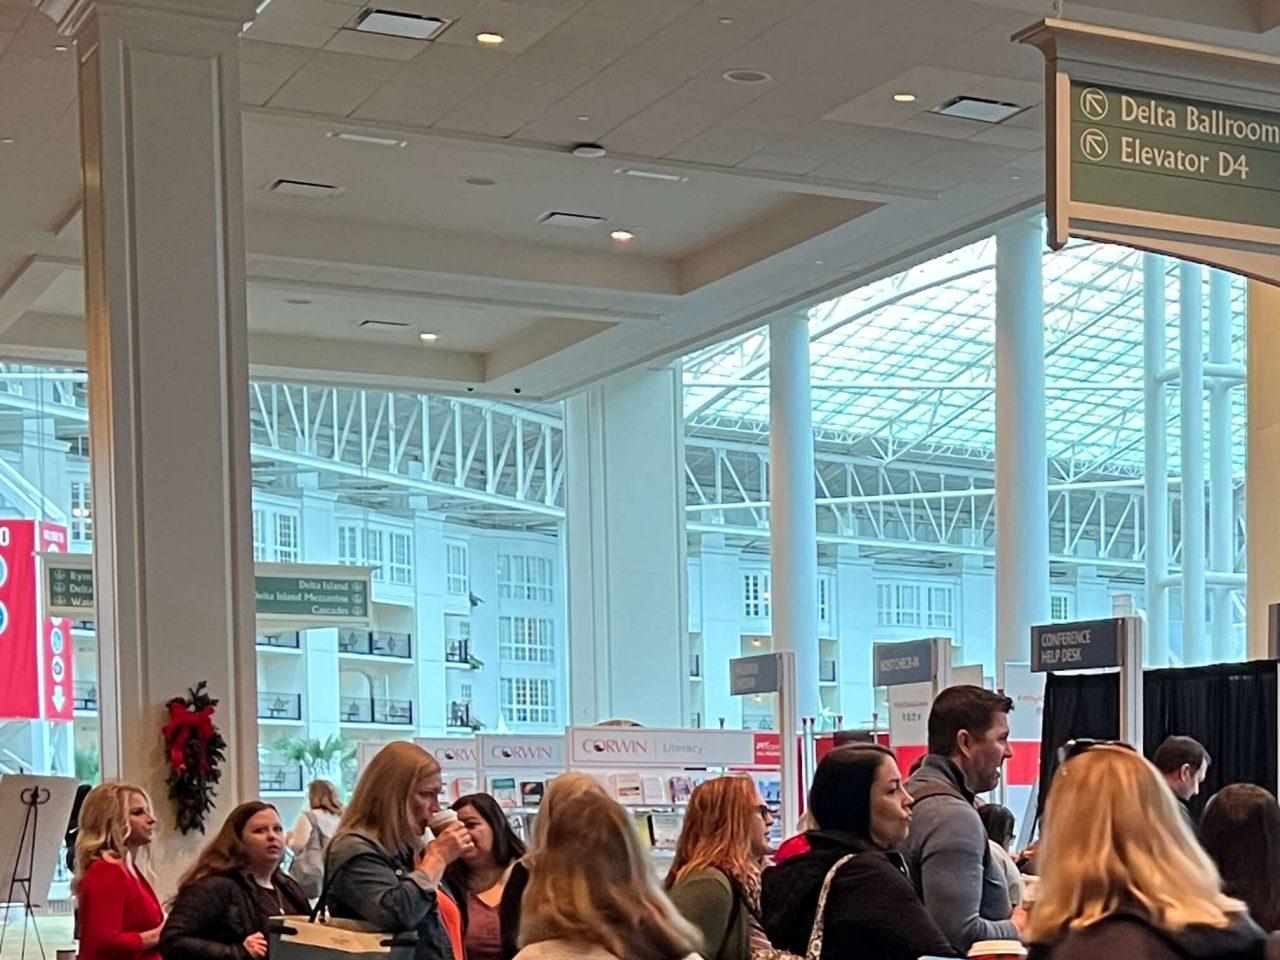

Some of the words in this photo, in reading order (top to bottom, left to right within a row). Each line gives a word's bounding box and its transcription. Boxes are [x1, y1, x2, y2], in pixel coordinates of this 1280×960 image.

[1121, 95, 1176, 128] Delta
[1186, 105, 1280, 144] Ballroom
[1121, 136, 1209, 173] Elevator
[1218, 151, 1249, 179] D4
[298, 580, 321, 590] Delta
[322, 581, 349, 591] Island
[276, 591, 302, 601] Island
[304, 593, 349, 603] Mezzanine
[311, 604, 349, 615] Cascades
[1041, 629, 1091, 648] CONFERENCE
[1041, 649, 1061, 664] HELP
[1062, 648, 1082, 662] DESK
[491, 746, 552, 759] CORWIN
[582, 738, 648, 754] CORWIN
[662, 743, 704, 755] Literacy
